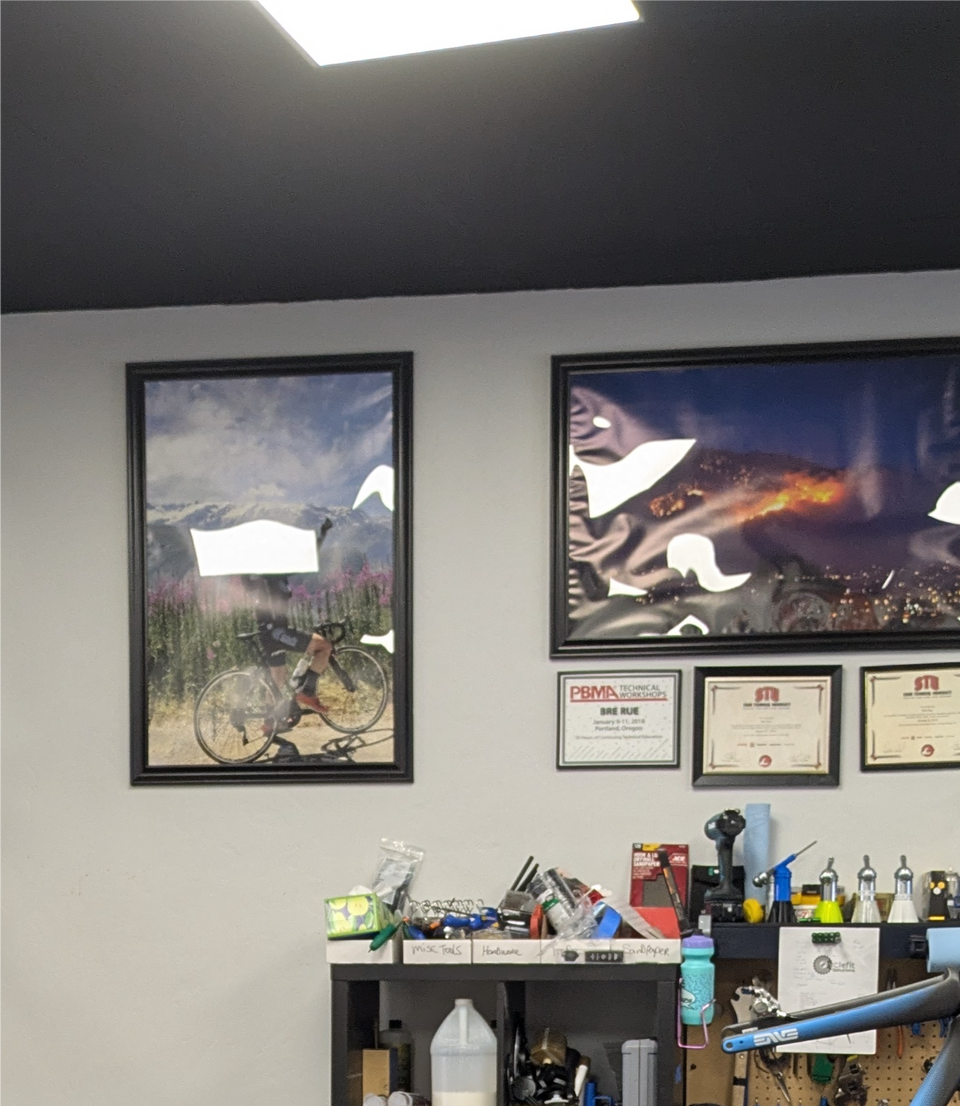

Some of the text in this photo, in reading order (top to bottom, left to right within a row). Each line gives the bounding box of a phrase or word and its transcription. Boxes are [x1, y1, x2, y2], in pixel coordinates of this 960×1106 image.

[570, 685, 619, 699] PBMA
[619, 684, 660, 692] TECHNICAL
[600, 706, 639, 716] BRE RUE
